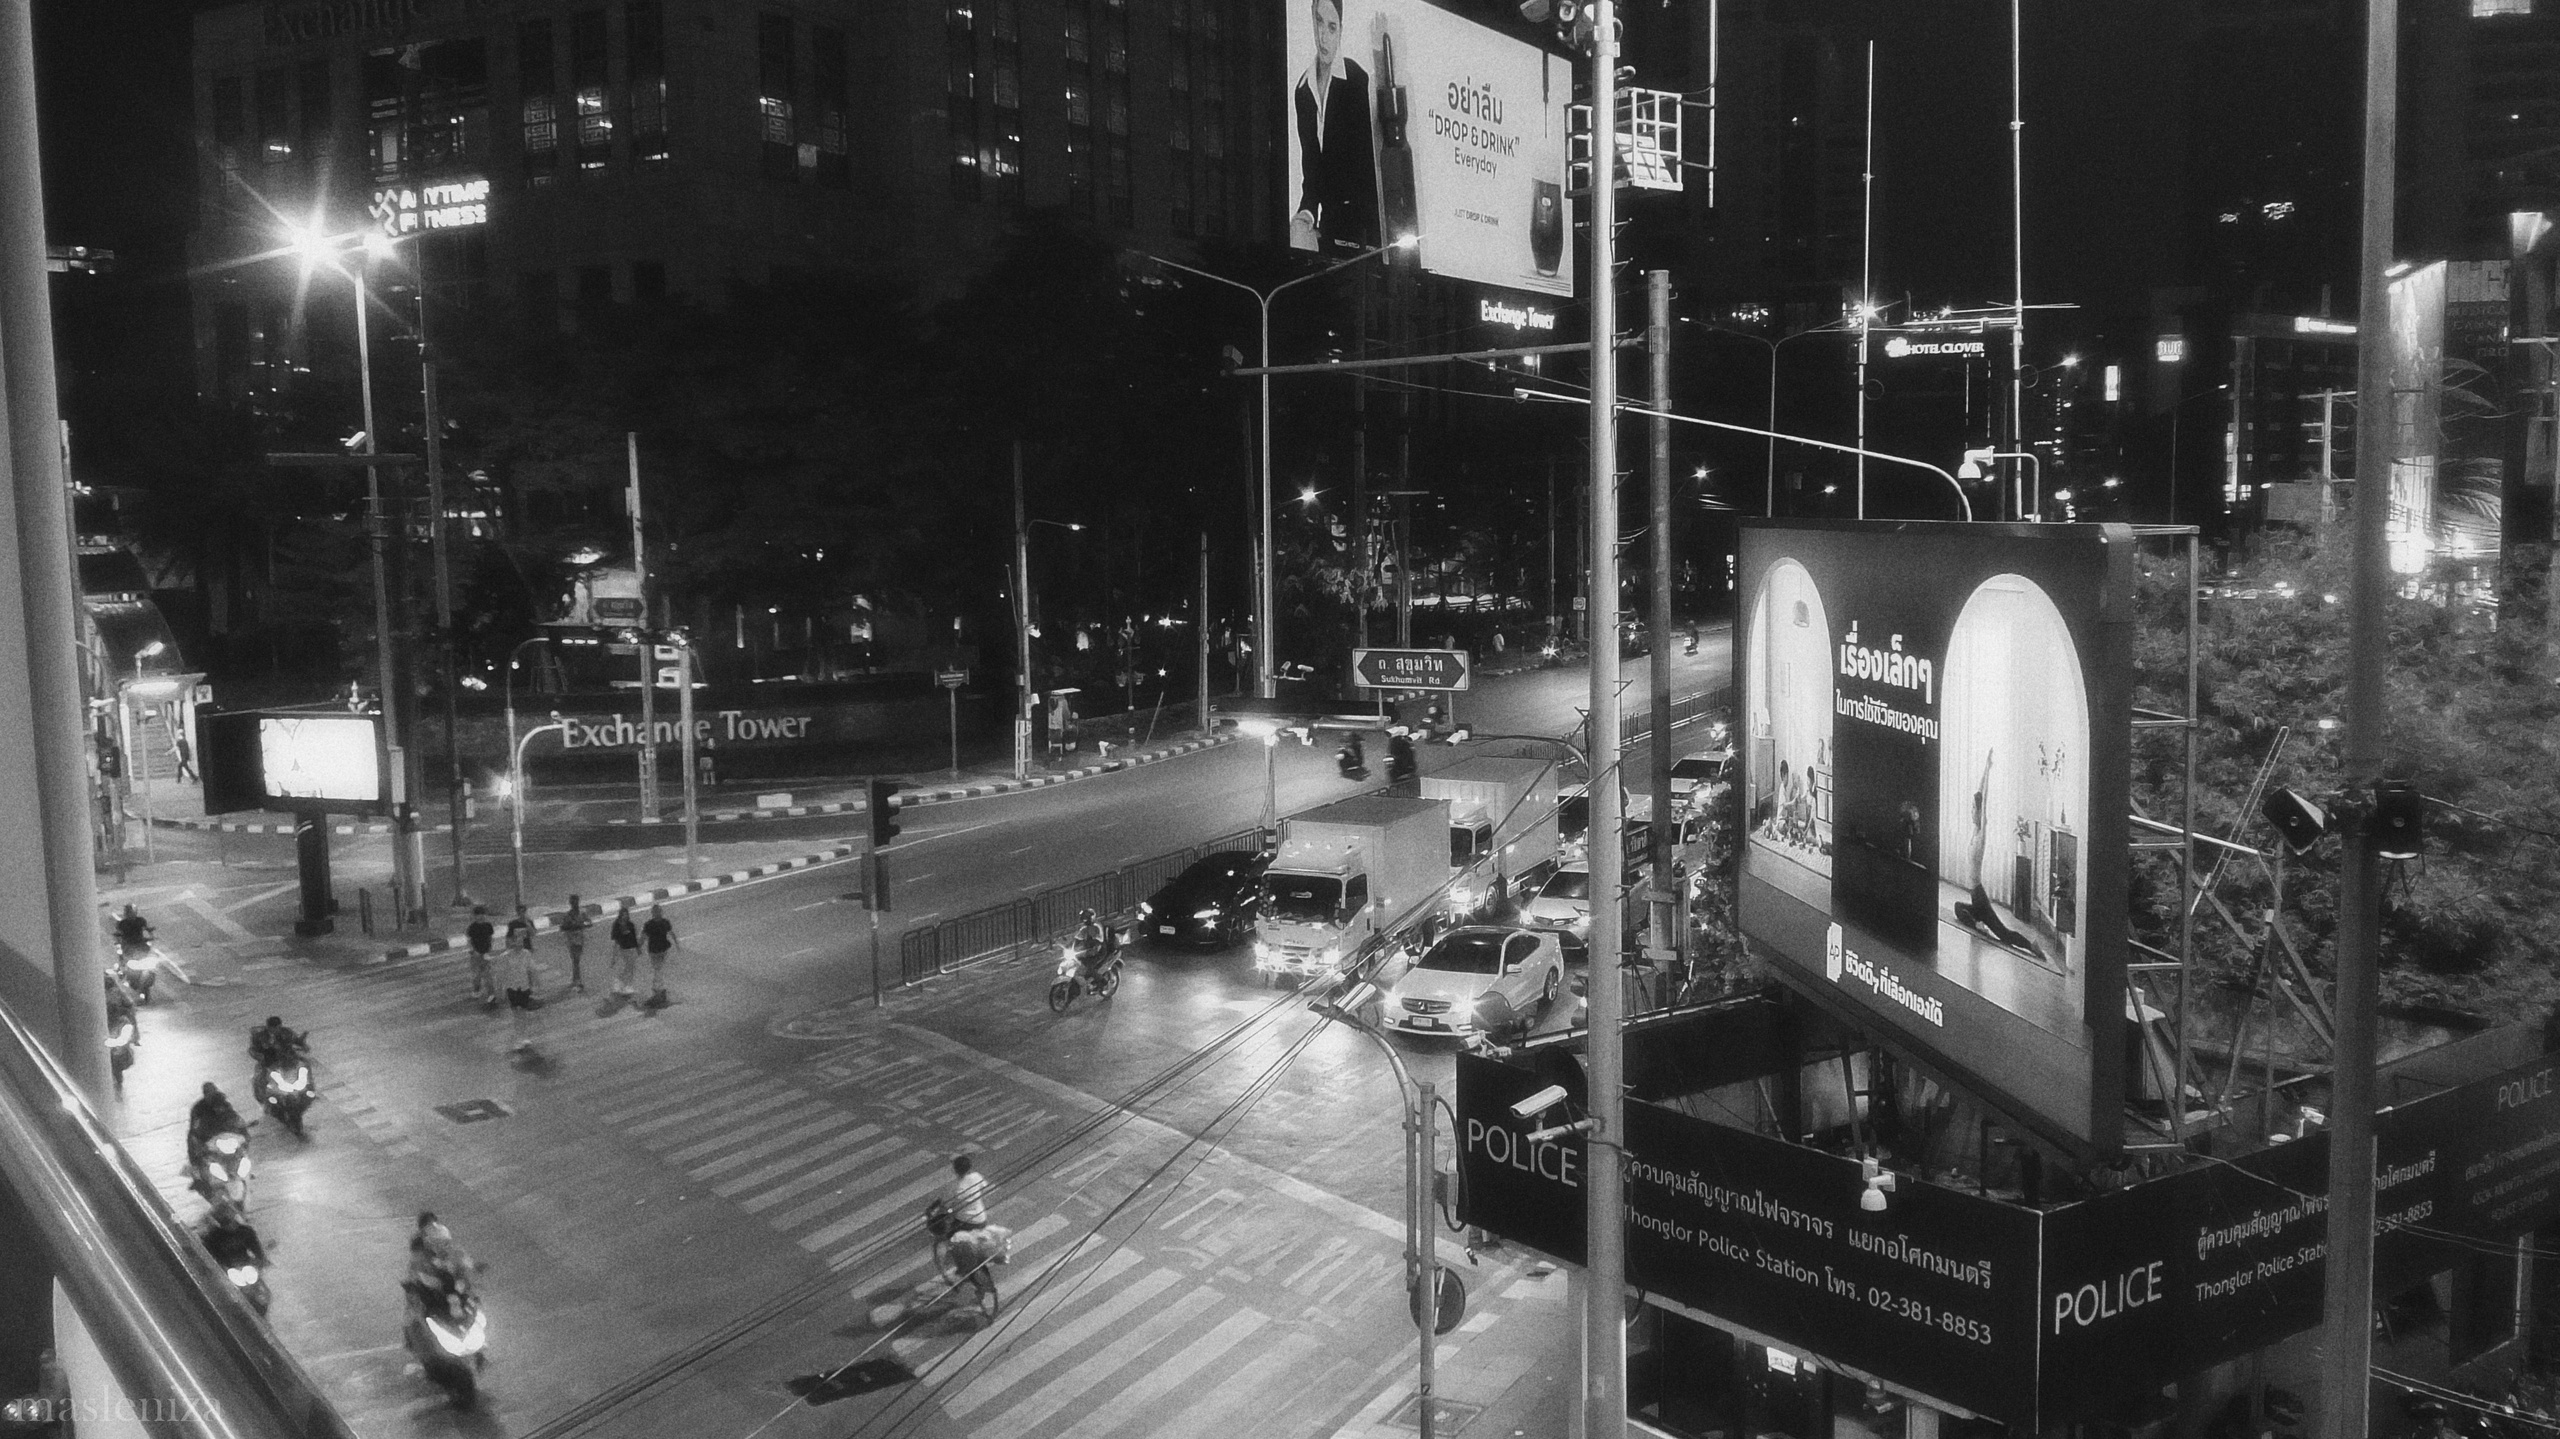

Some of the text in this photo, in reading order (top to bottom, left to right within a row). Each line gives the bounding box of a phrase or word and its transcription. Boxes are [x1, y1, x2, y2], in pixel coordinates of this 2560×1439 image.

[1470, 125, 1479, 147] &
[1454, 146, 1498, 179] Everyday
[1481, 300, 1555, 330] Exchange Tower
[1907, 342, 1985, 354] HOTEL CLOVER
[1381, 675, 1422, 684] Sukhumvit
[1396, 654, 1443, 675] สุขุมวิท
[719, 710, 812, 740] Tower
[2498, 1068, 2553, 1112] POLICE
[1468, 1117, 1578, 1187] POLICE
[1624, 1203, 1693, 1243] Thonglor
[1699, 1229, 1750, 1262] Police
[1756, 1249, 1819, 1287] Station
[1868, 1286, 1992, 1345] 02-381-8853
[2196, 1270, 2253, 1302] Thonglor
[2257, 1254, 2294, 1280] Police
[2055, 1260, 2163, 1335] POLICE
